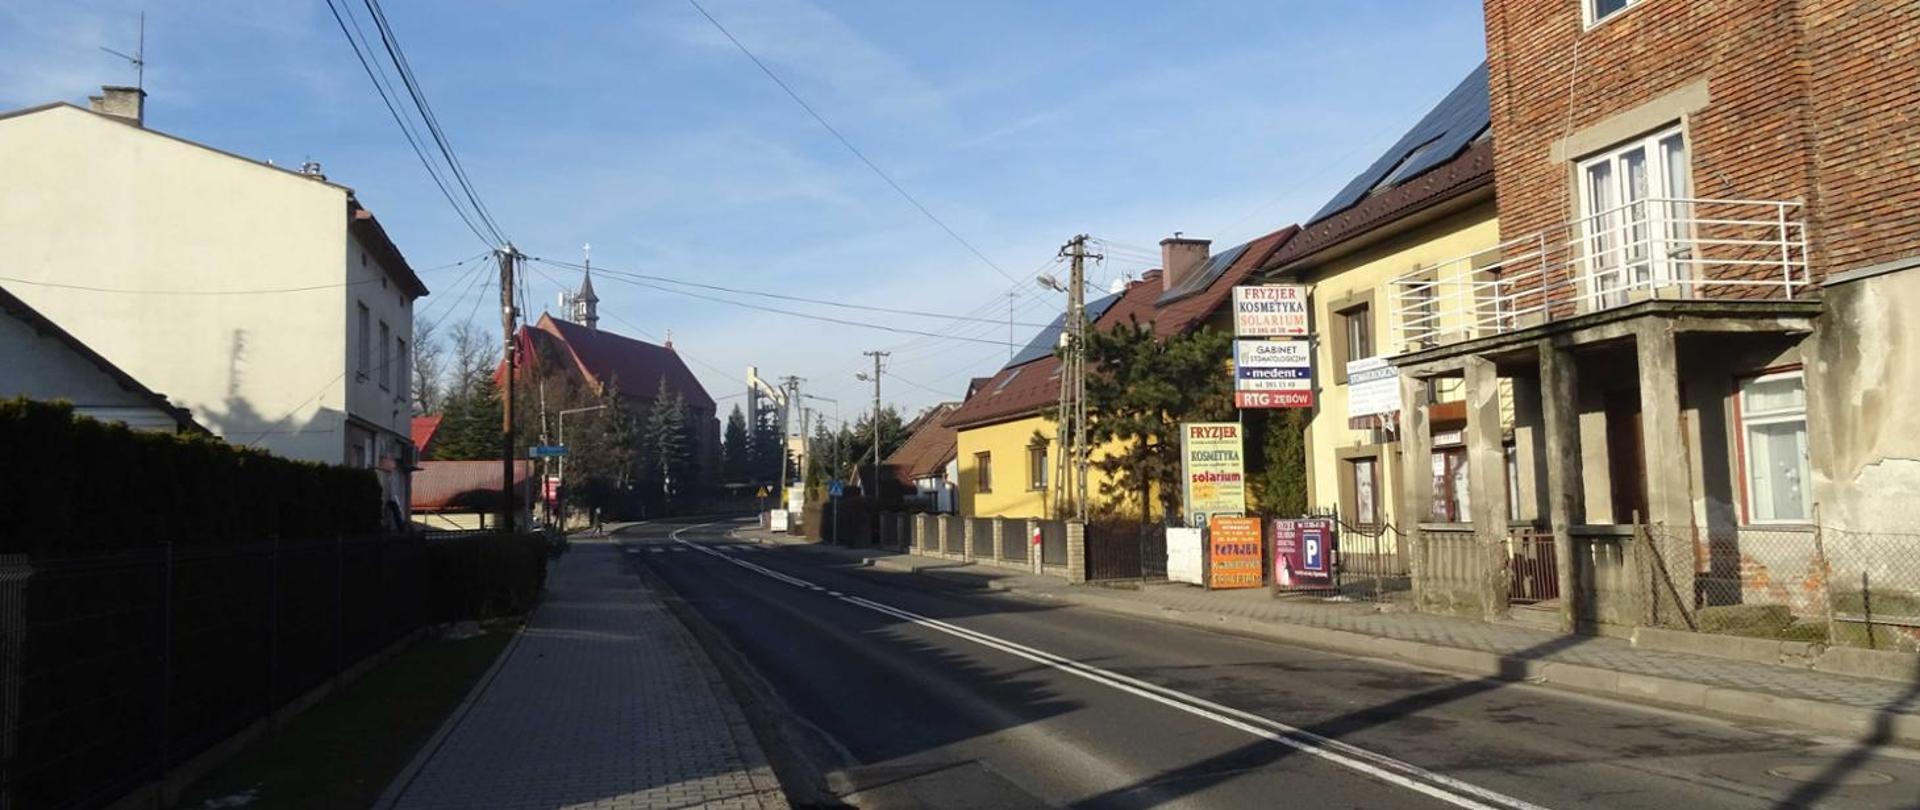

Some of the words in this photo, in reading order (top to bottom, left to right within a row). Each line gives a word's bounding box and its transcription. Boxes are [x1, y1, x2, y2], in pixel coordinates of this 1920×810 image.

[1244, 288, 1296, 301] FRYZJER
[1239, 301, 1305, 313] KOSMETYKA
[1240, 315, 1305, 326] SOLARIUM
[1256, 345, 1297, 354] GABINET
[1252, 368, 1297, 378] medent
[1243, 392, 1271, 406] RTG
[1273, 393, 1309, 406] ZĘBÓW
[1190, 426, 1238, 440] FRYZJER
[1190, 450, 1241, 462] KOSMETYKA
[1191, 470, 1241, 482] solarium
[1306, 539, 1318, 565] P
